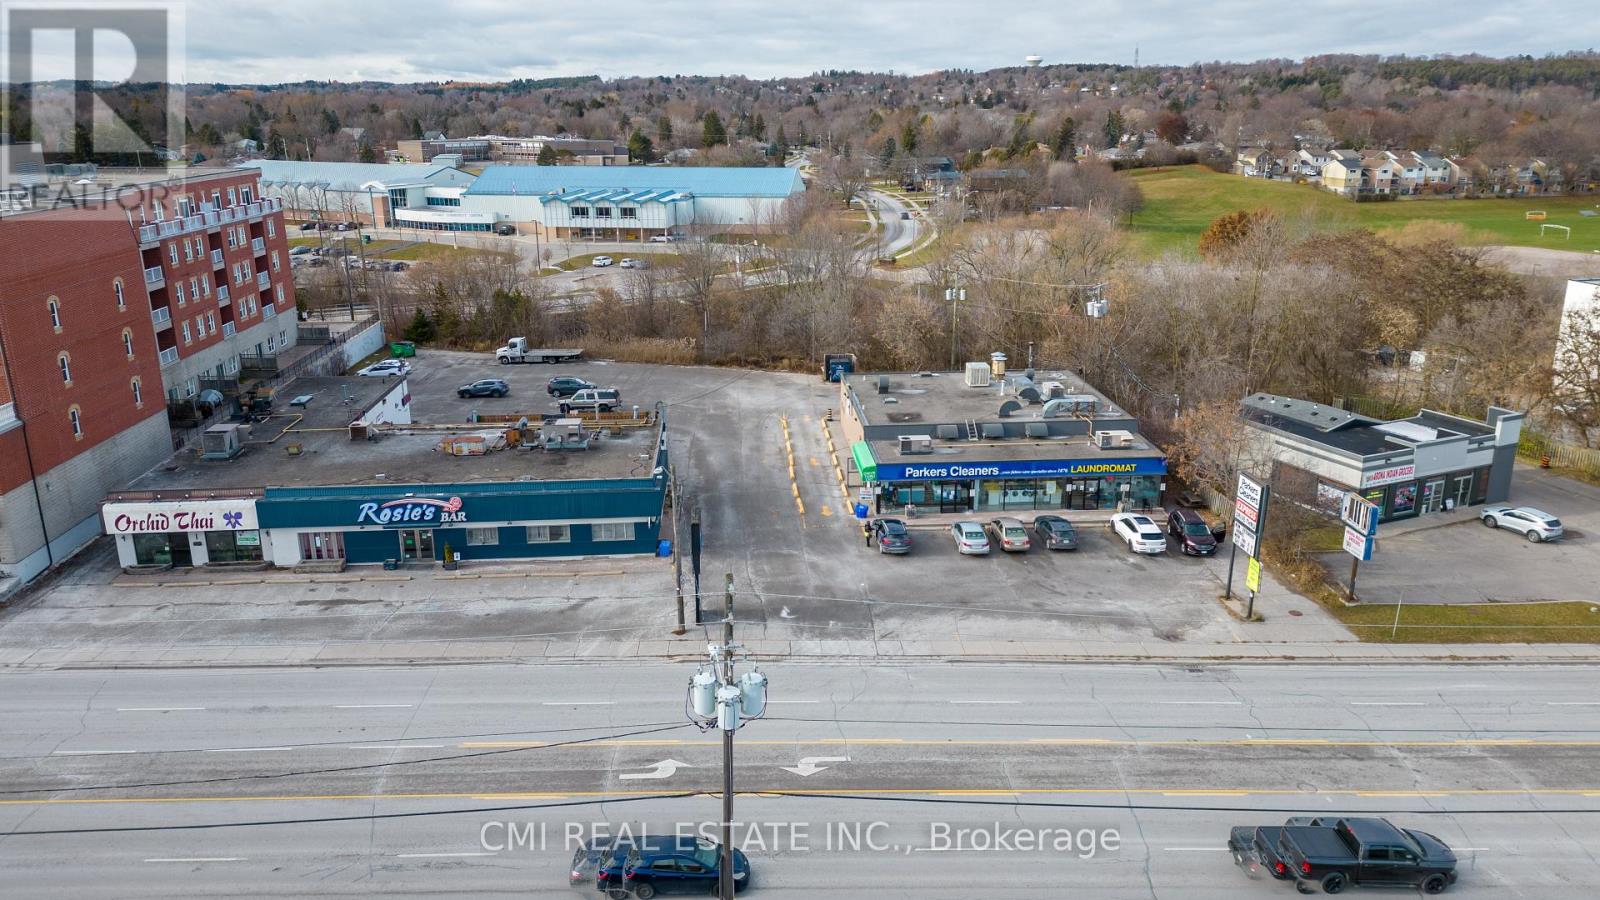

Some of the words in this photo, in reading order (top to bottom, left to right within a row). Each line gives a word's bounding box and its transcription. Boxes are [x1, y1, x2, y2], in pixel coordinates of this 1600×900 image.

[905, 467, 947, 478] Parkers
[950, 466, 999, 477] Cleaners
[1071, 464, 1137, 473] LAUNDROMAT
[357, 502, 436, 524] Rosie's
[440, 511, 467, 522] BAR
[115, 511, 169, 532] Orchid
[174, 512, 214, 530] Thai
